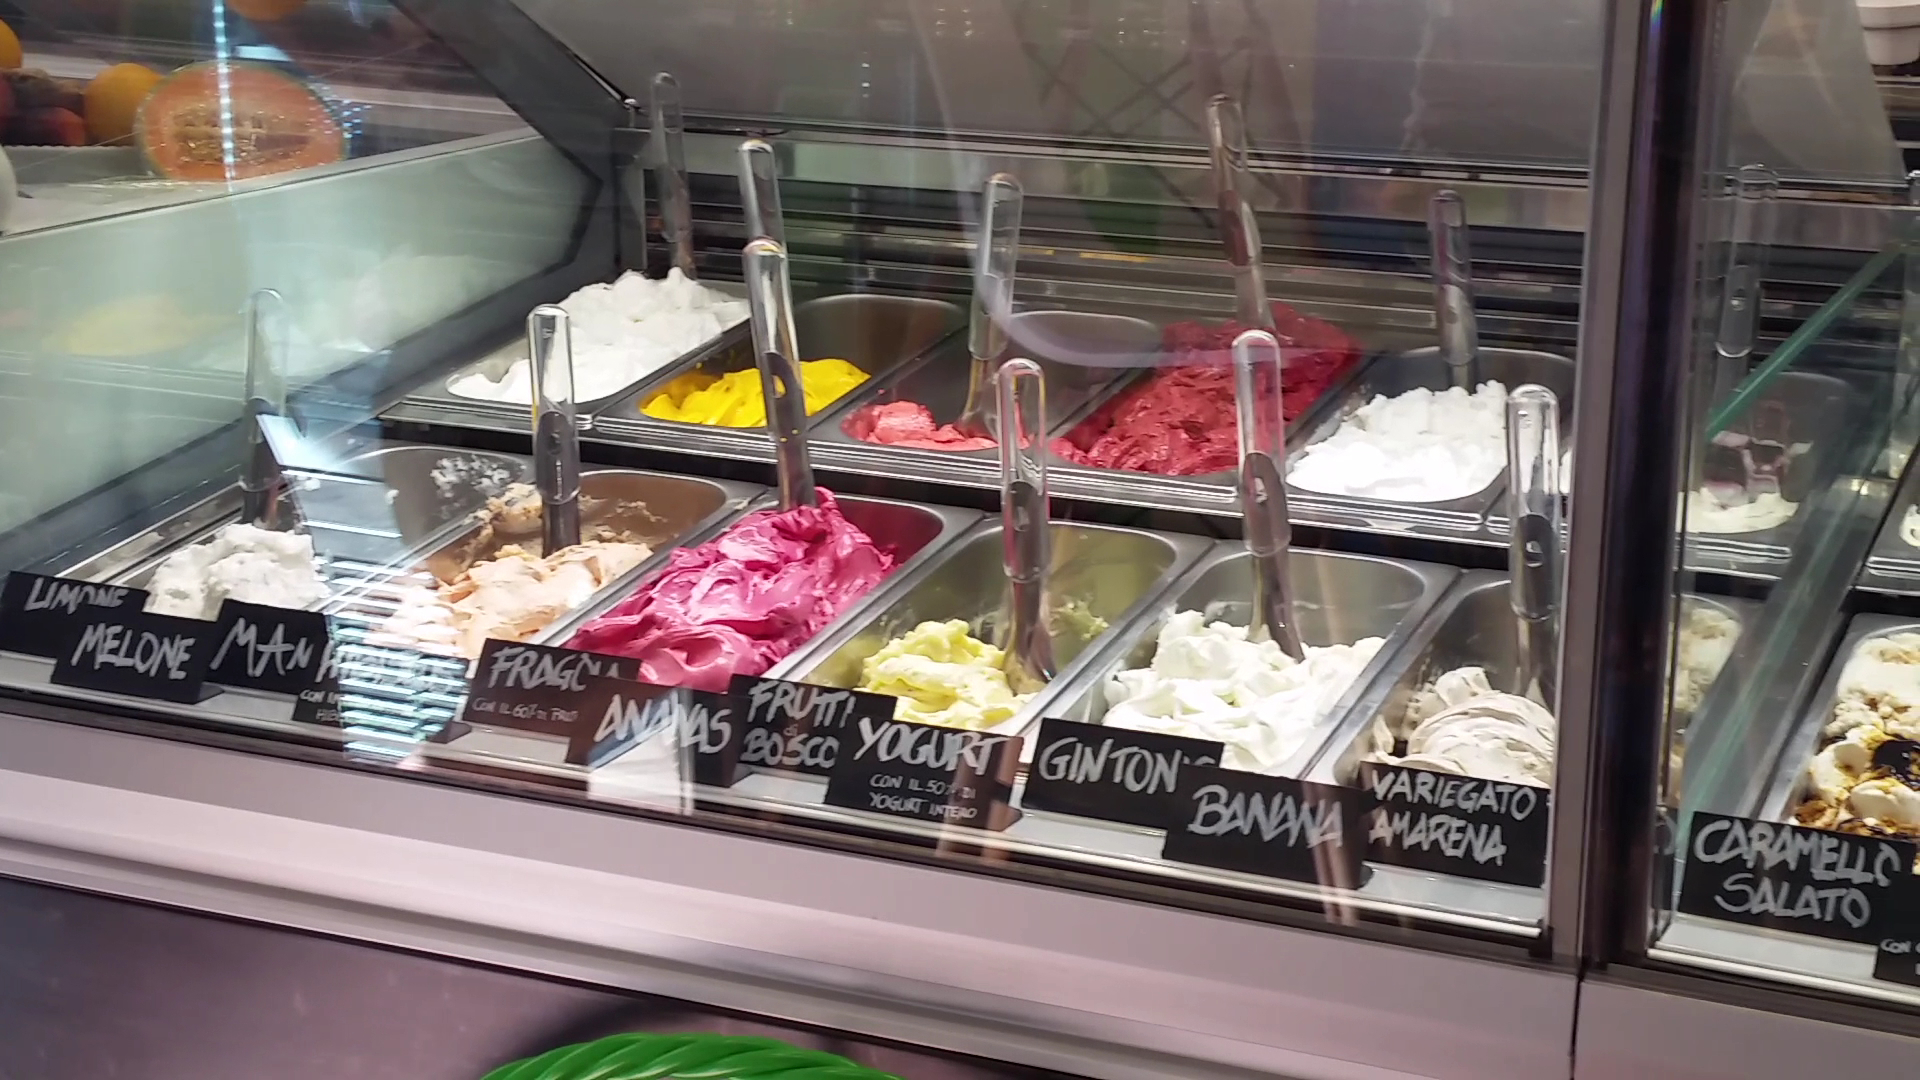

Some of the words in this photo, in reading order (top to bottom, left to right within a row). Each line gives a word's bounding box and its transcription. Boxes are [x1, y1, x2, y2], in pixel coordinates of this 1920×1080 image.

[70, 622, 196, 680] MELONE
[209, 617, 315, 677] MAN
[593, 690, 733, 754] ANANAS
[747, 680, 857, 728] FRUTTI
[740, 727, 840, 769] BOSCO
[853, 716, 1012, 775] YOGURT
[869, 774, 903, 788] CON
[869, 791, 929, 813] YOGURT
[928, 802, 978, 820] INTERO
[1371, 769, 1537, 821] VARIEGATO
[1187, 784, 1344, 849] BANANA
[1367, 807, 1508, 866] AMARENA
[1694, 819, 1901, 887] CARAMELLO
[1714, 872, 1872, 928] SALATO
[1880, 939, 1912, 954] CON
